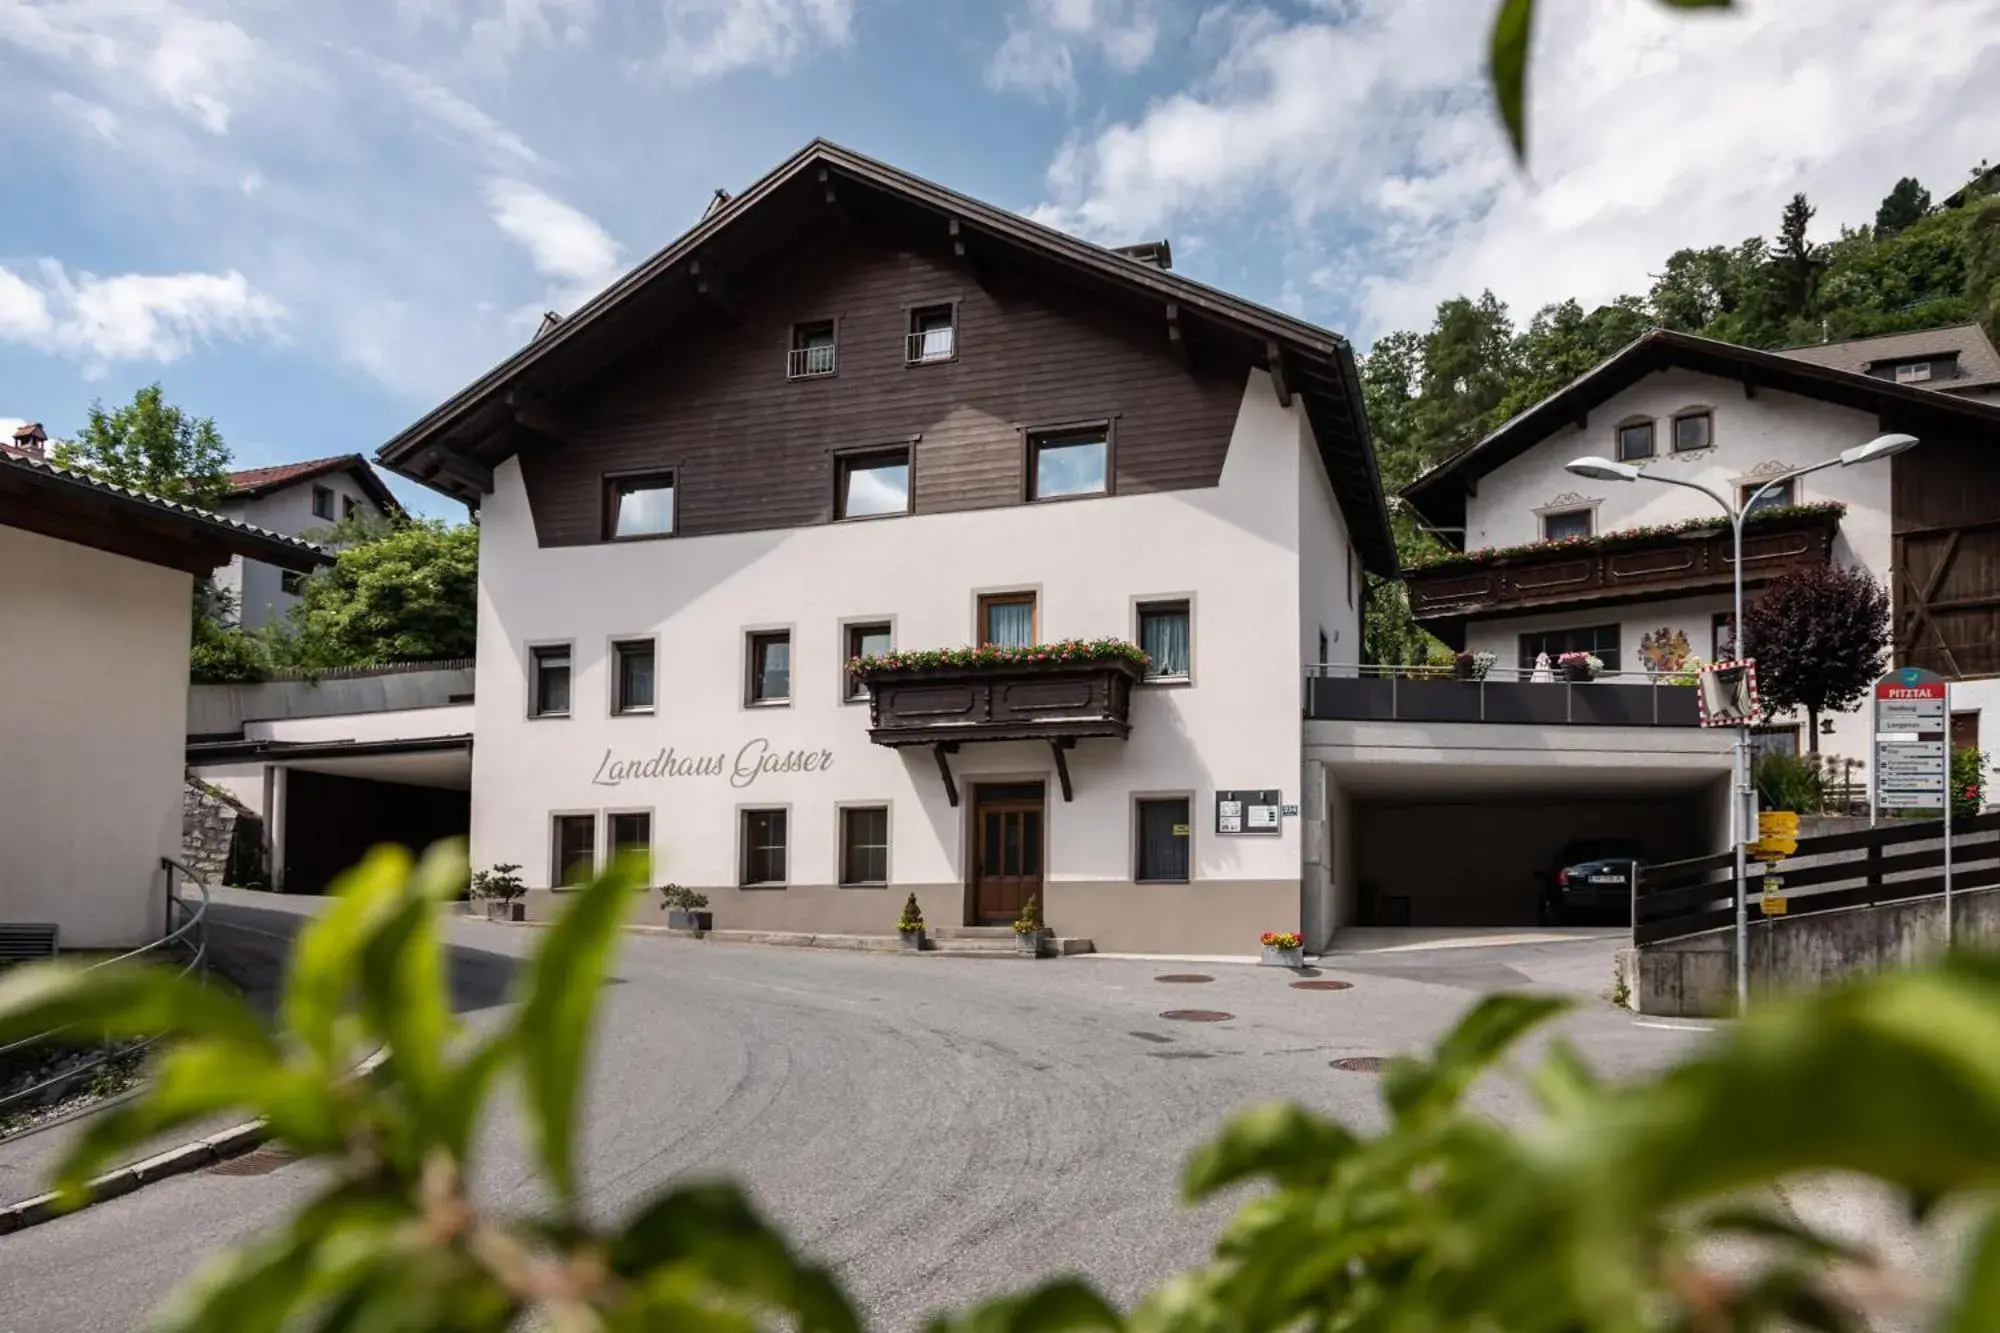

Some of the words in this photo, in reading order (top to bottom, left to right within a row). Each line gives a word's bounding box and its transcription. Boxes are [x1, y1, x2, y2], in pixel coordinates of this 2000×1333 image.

[1888, 688, 1933, 698] PITZTAL
[591, 747, 726, 786] Landhaus
[729, 738, 834, 788] Gasser
